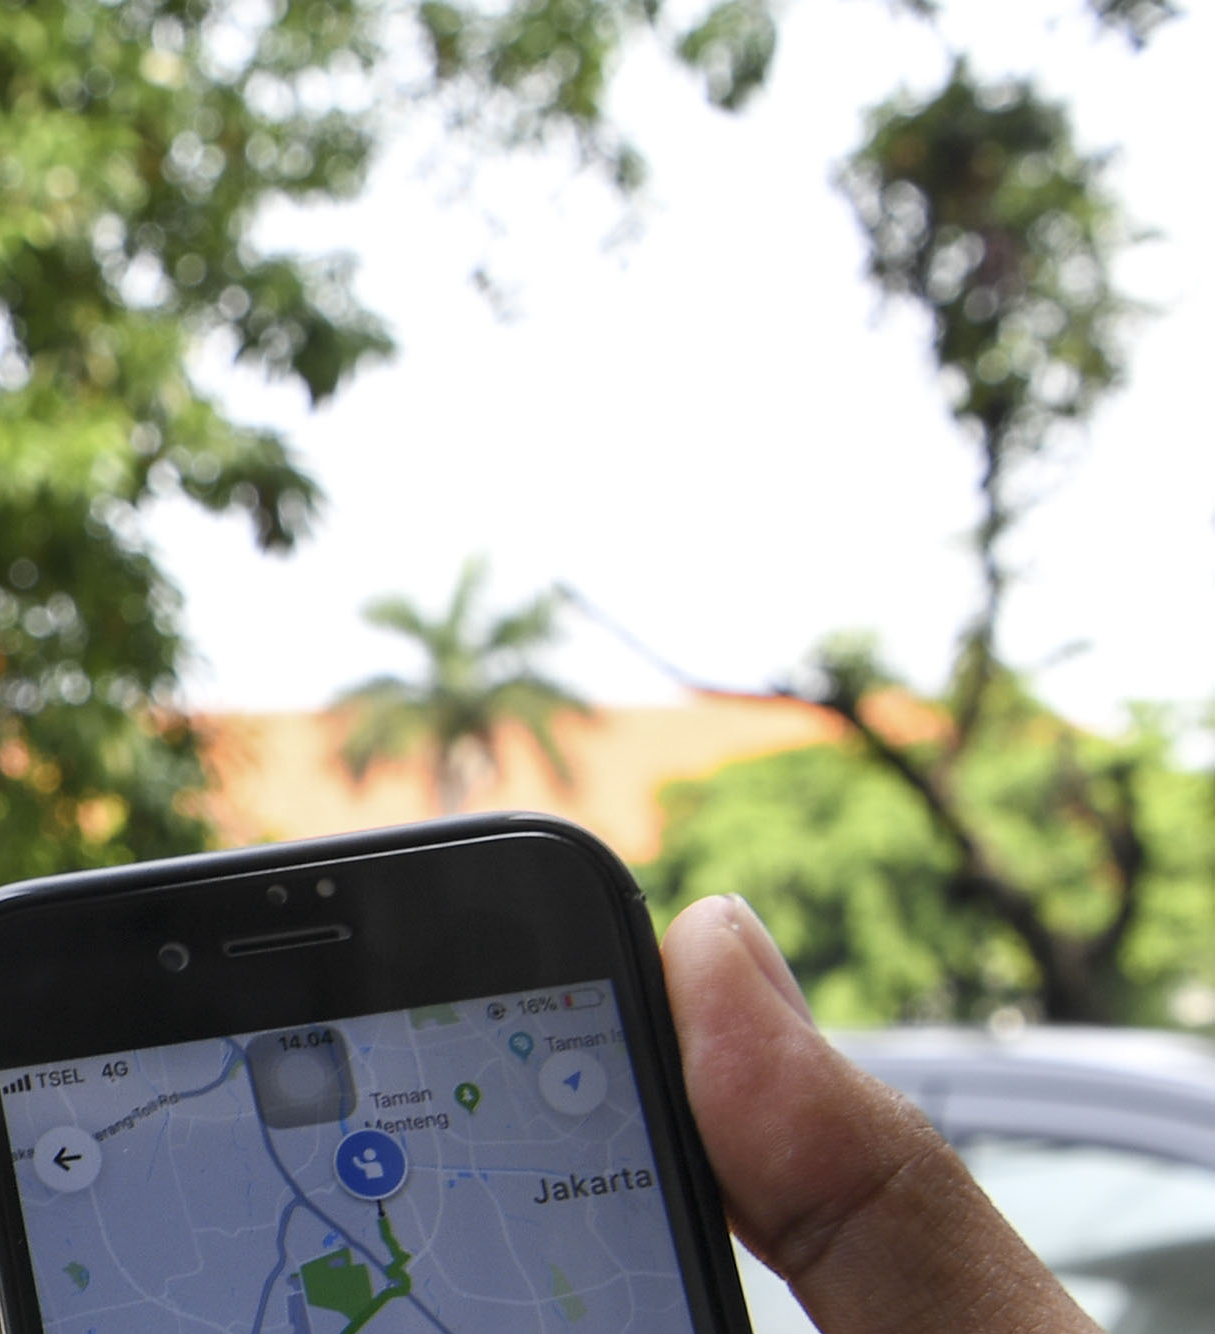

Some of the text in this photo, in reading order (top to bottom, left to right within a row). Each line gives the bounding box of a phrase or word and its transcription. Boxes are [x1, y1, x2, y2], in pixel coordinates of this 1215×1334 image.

[517, 996, 559, 1015] 16%
[279, 1029, 335, 1051] 14.04
[544, 1031, 607, 1053] Taman
[36, 1061, 129, 1088] TSEL 4G
[370, 1088, 433, 1109] Taman
[534, 1168, 654, 1204] Jakarta
